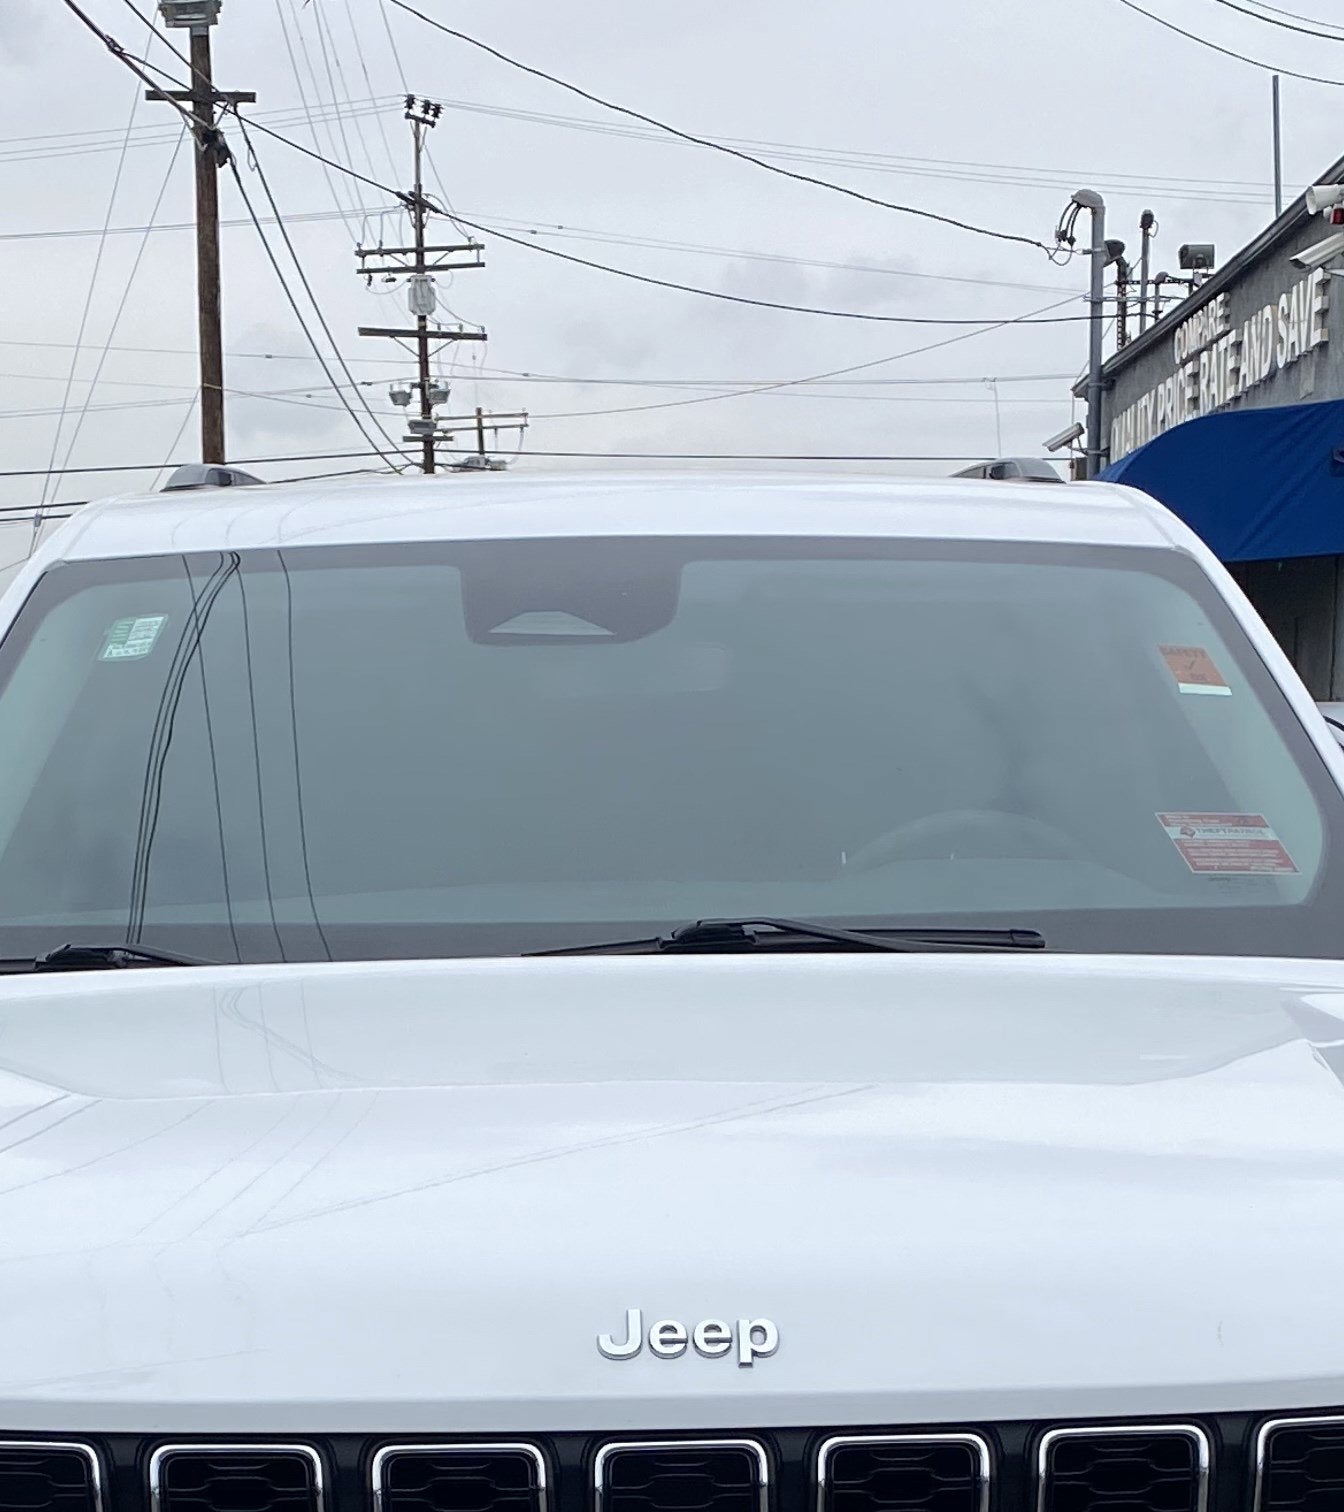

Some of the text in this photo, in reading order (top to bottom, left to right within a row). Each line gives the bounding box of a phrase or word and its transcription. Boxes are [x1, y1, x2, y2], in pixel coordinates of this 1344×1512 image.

[1157, 360, 1198, 435] PRICE
[1199, 329, 1238, 415] RATE
[1238, 304, 1274, 393] AND
[1276, 267, 1327, 368] SAVE
[596, 1308, 780, 1369] Jeep
